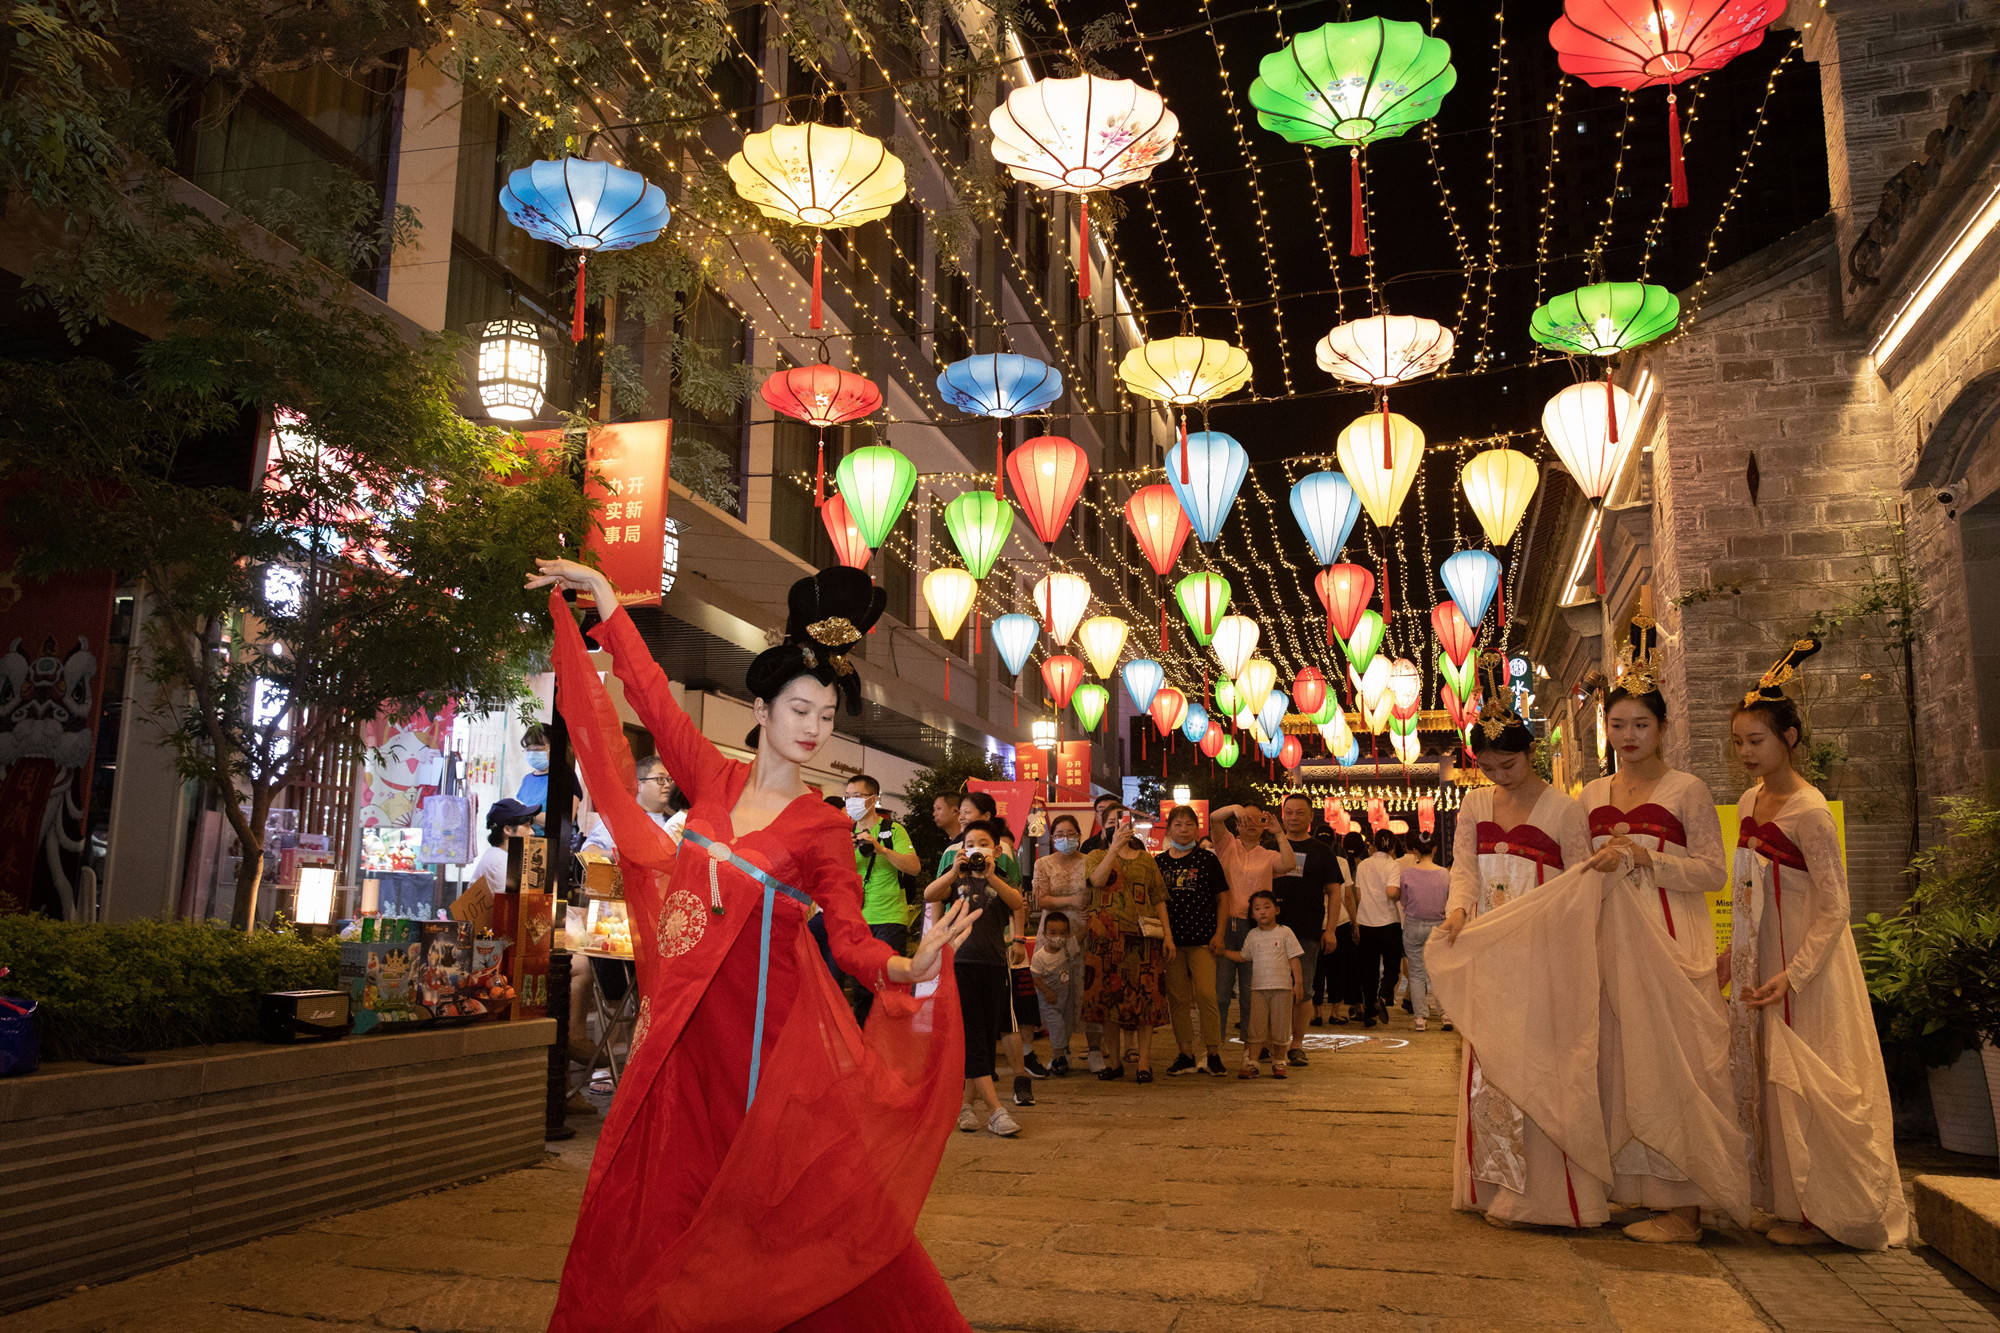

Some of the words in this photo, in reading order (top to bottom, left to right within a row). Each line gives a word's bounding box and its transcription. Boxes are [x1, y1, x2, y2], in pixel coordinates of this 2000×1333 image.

[604, 477, 624, 545] 办实事
[624, 476, 645, 544] 开新局
